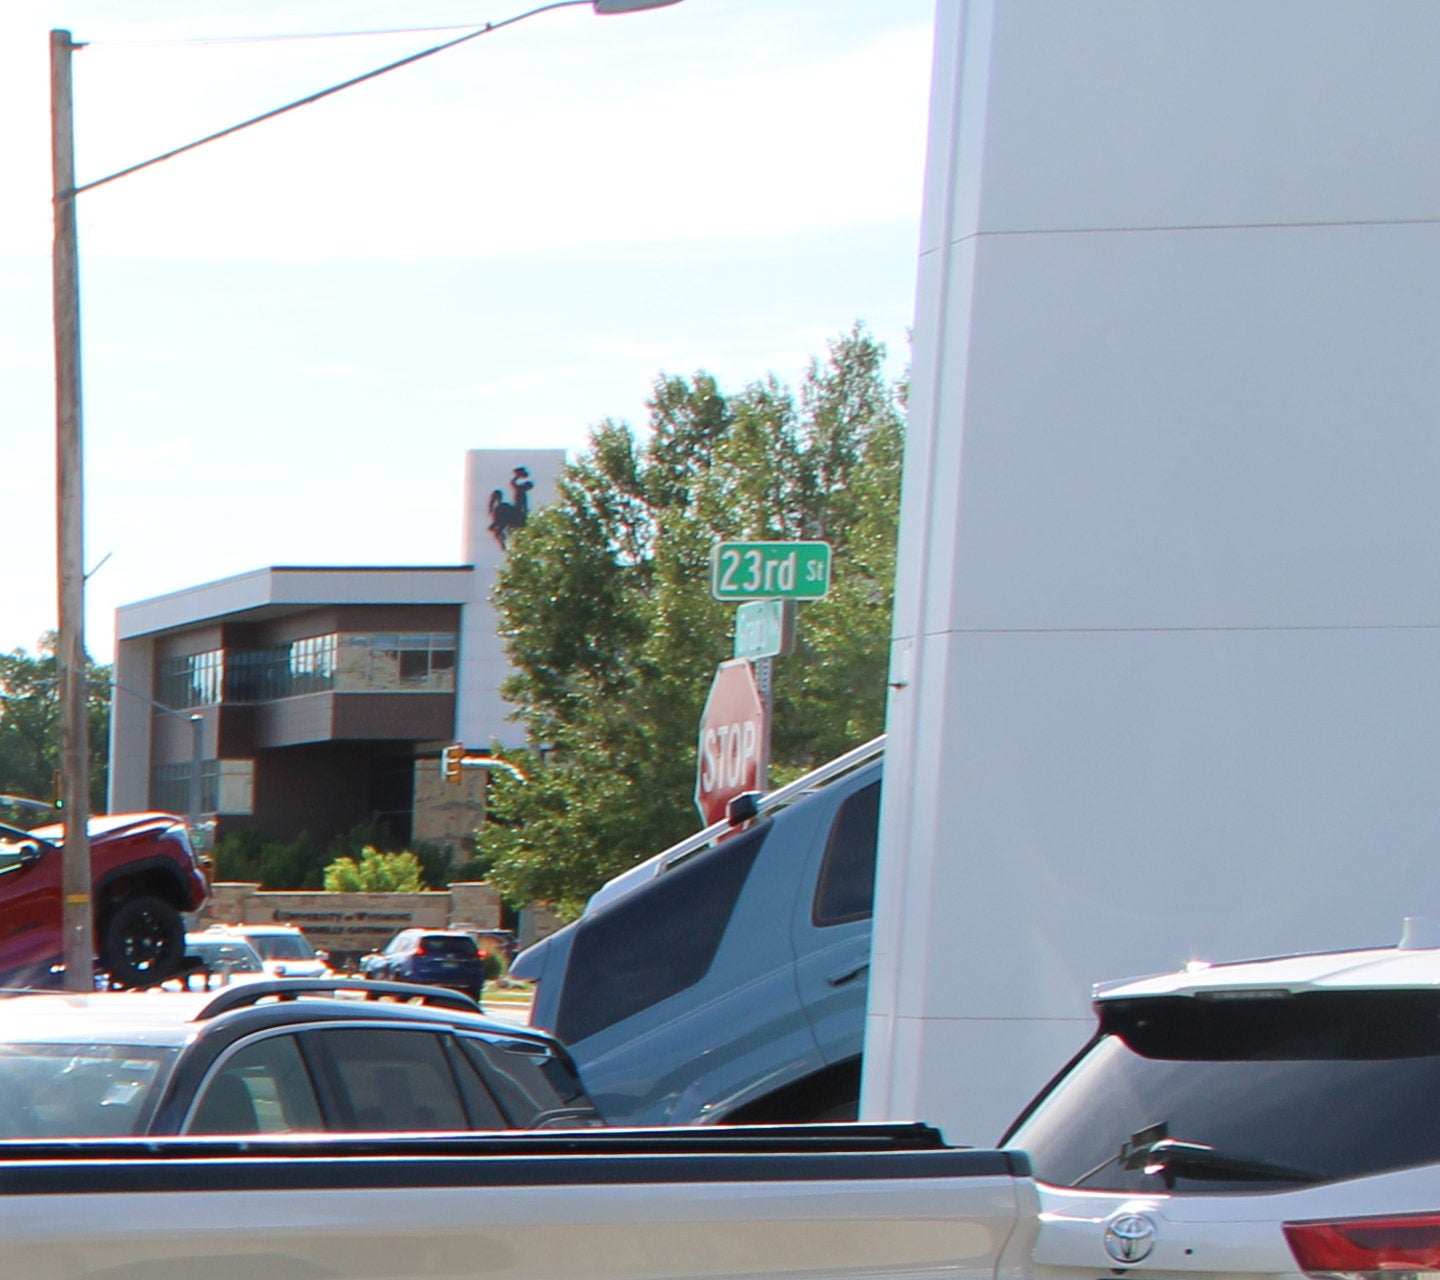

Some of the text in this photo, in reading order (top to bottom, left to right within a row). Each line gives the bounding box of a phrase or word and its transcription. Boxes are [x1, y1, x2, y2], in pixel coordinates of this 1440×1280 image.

[719, 549, 825, 592] 23rd St
[702, 720, 757, 793] STOP
